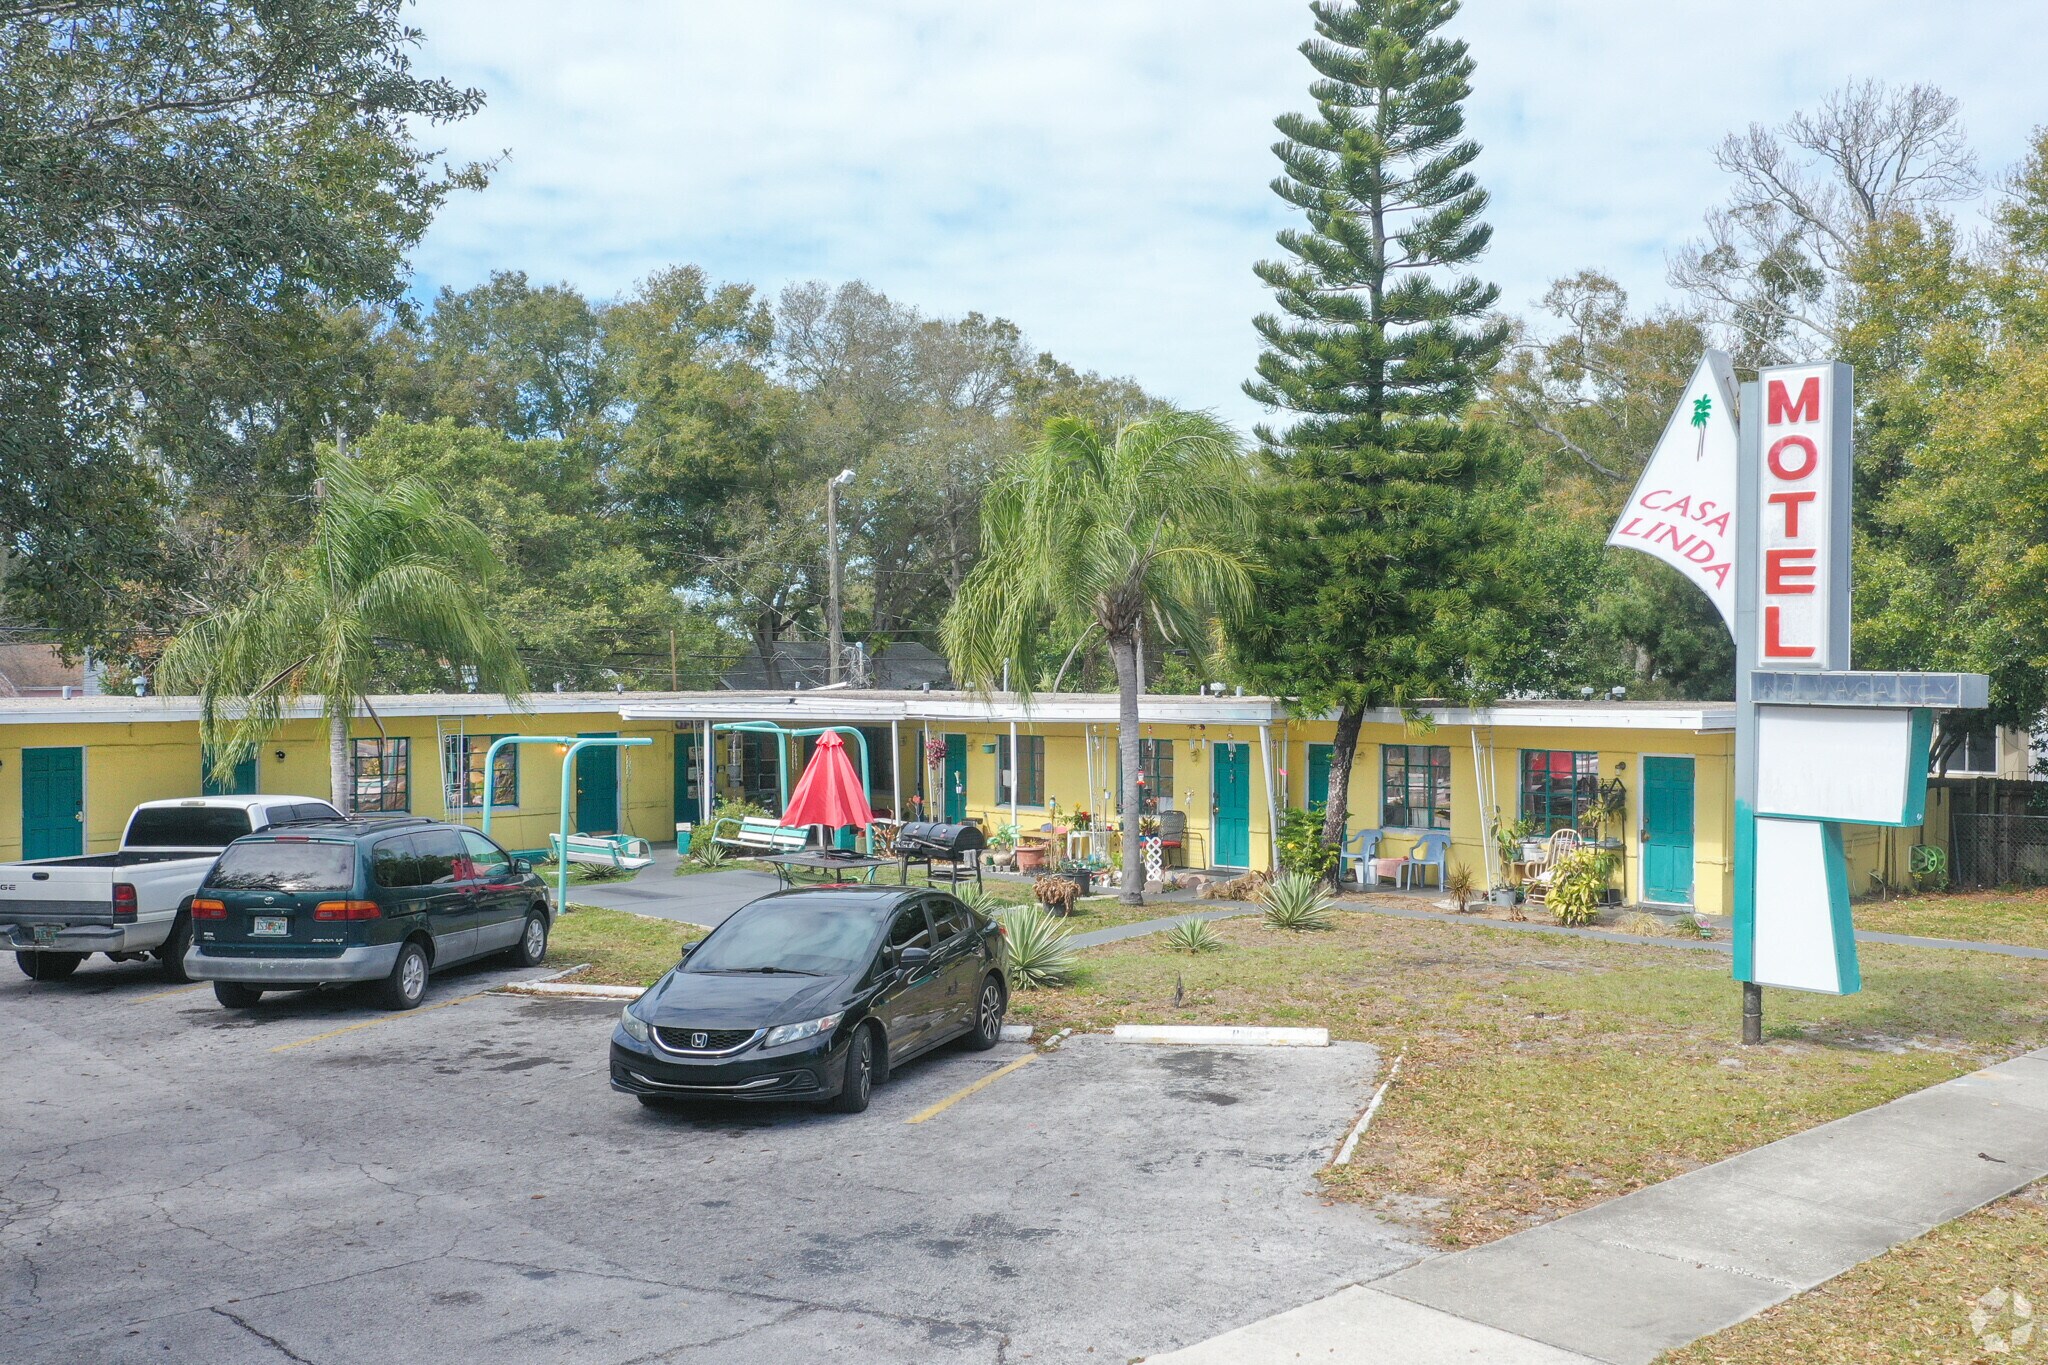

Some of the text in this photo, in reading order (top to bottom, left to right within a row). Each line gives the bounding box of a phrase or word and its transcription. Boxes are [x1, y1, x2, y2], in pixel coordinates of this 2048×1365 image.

[1639, 489, 1732, 538] CASA
[1765, 376, 1820, 658] MOTEL
[1618, 517, 1732, 590] LINDA
[1763, 681, 1795, 696] NO
